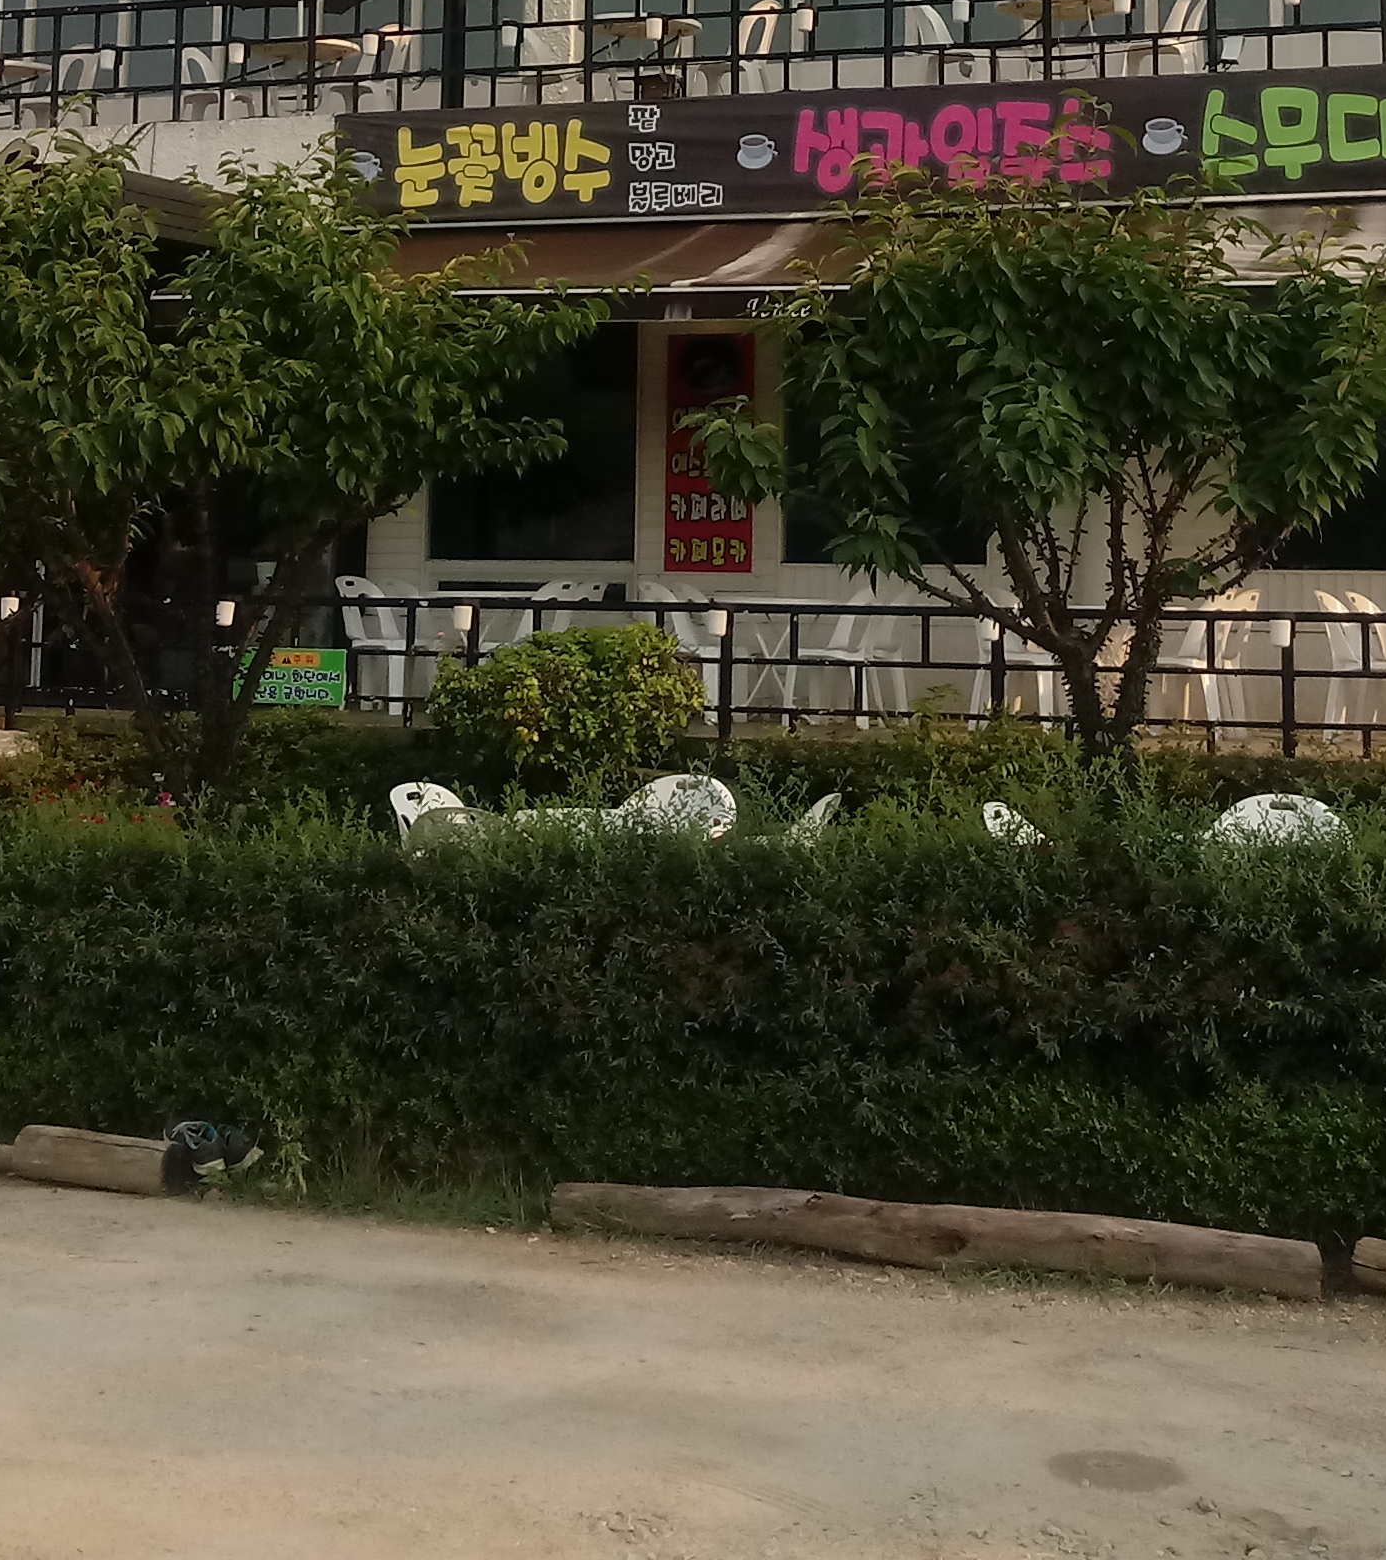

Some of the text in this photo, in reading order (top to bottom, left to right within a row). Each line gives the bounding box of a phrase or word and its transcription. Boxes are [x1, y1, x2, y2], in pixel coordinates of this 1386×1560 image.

[395, 119, 613, 208] 눈꽃빙수
[628, 142, 676, 171] 망고
[628, 181, 724, 213] 블루베리
[669, 537, 748, 566] 카페모카
